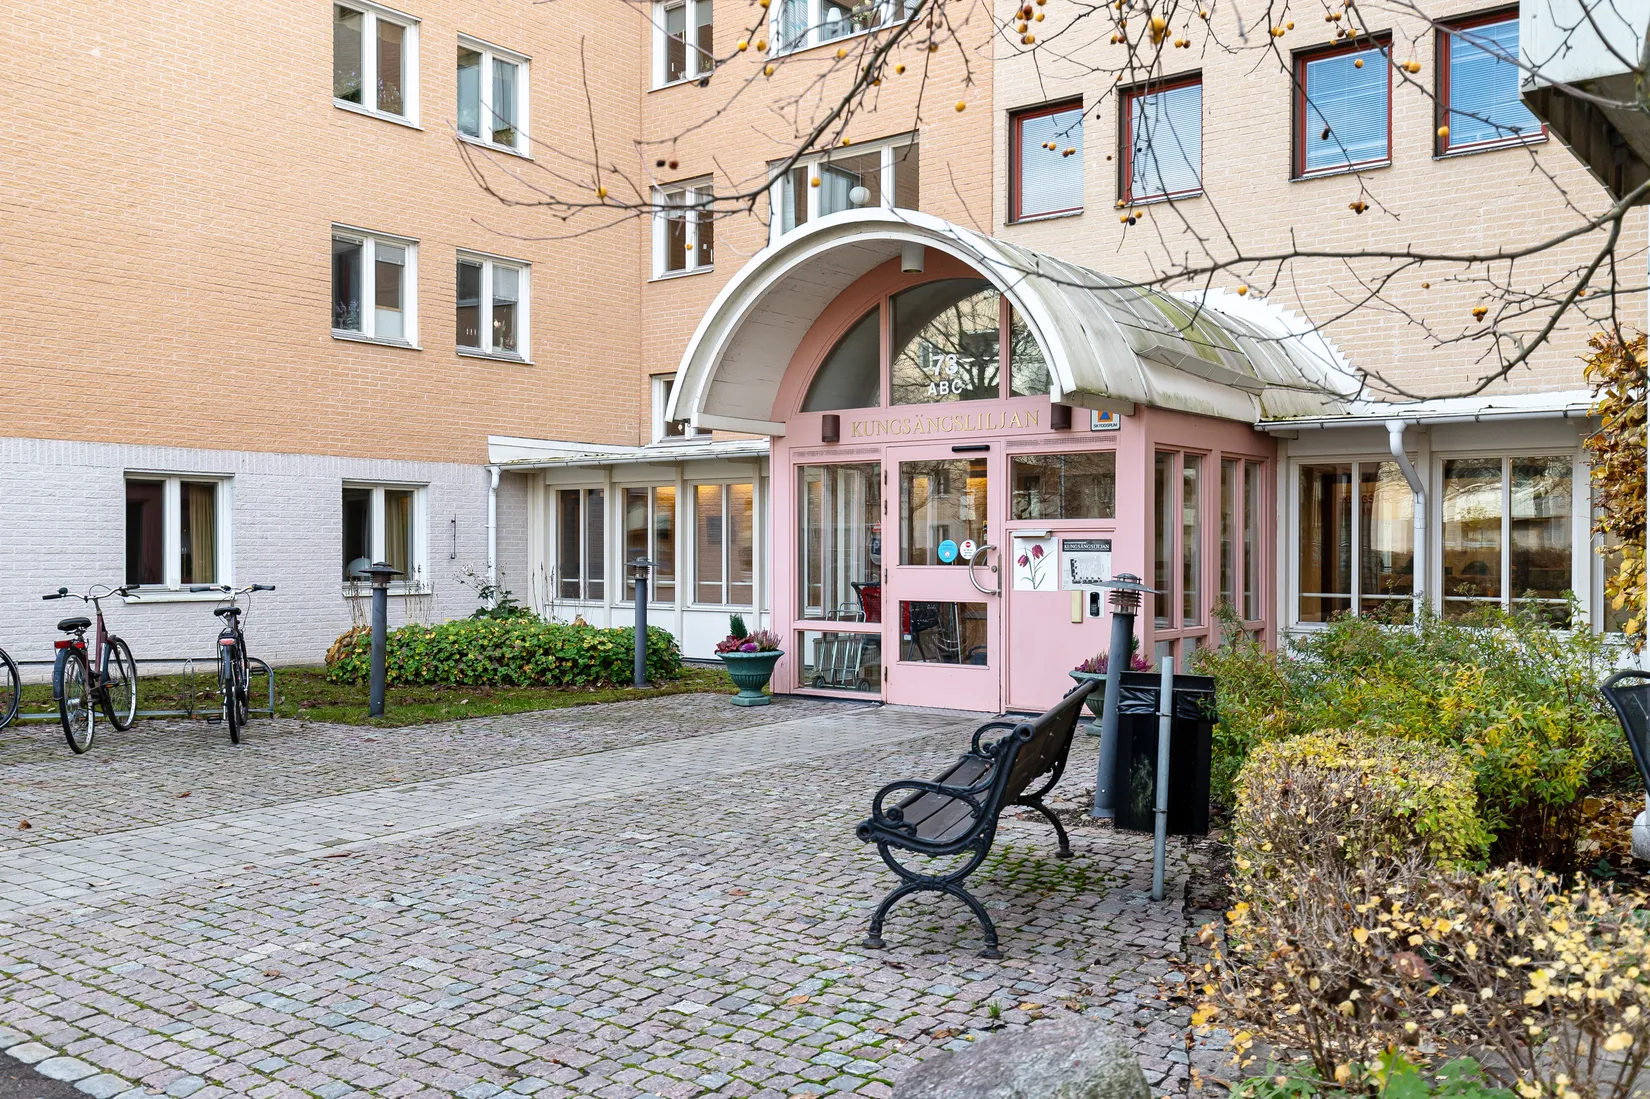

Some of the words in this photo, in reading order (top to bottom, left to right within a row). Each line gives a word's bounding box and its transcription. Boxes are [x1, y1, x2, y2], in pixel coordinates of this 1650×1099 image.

[932, 353, 958, 376] 73
[928, 379, 962, 396] ABC
[851, 409, 1040, 438] KUNGSÄNGSLILJAN
